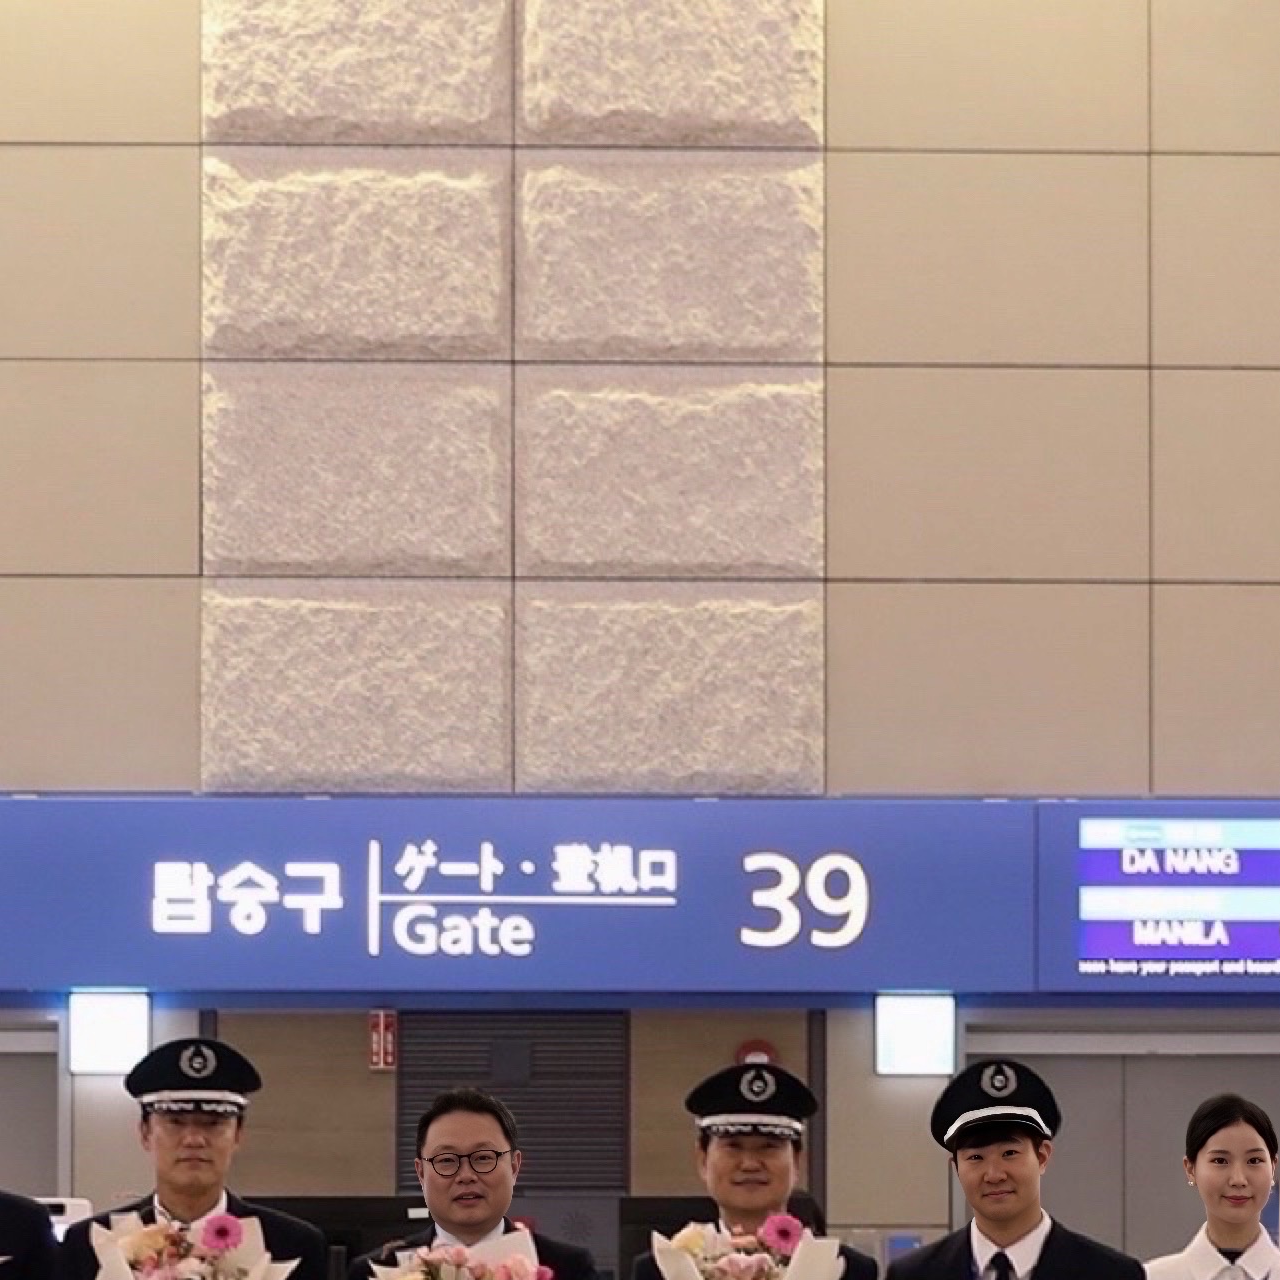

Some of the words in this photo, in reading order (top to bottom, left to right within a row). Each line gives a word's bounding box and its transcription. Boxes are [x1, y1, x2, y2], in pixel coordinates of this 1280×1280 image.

[153, 862, 343, 934] 탑승구
[393, 905, 534, 955] Gate
[741, 853, 867, 946] 39
